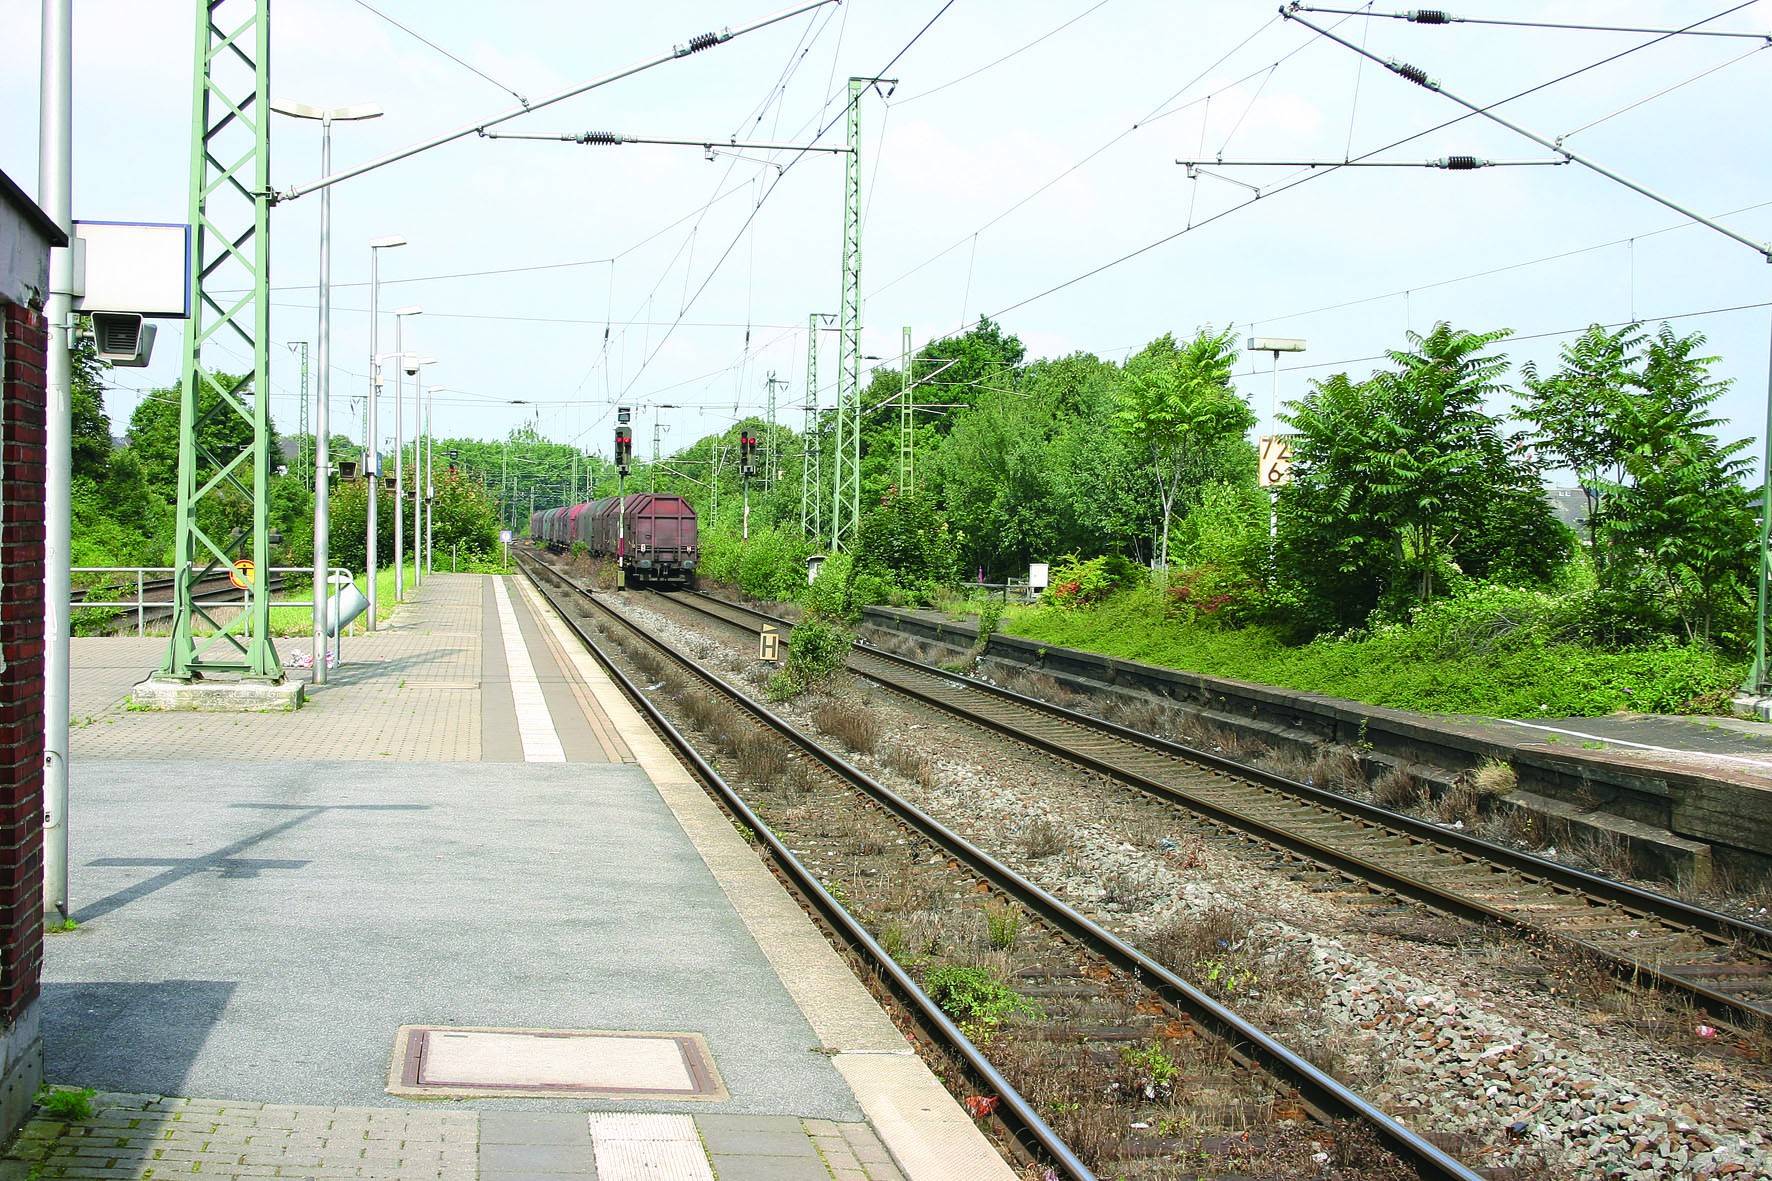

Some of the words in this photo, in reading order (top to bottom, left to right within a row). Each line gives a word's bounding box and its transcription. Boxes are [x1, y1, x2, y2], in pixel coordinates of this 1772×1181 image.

[1262, 438, 1290, 460] 72
[1268, 462, 1281, 482] 6
[762, 635, 777, 658] H
